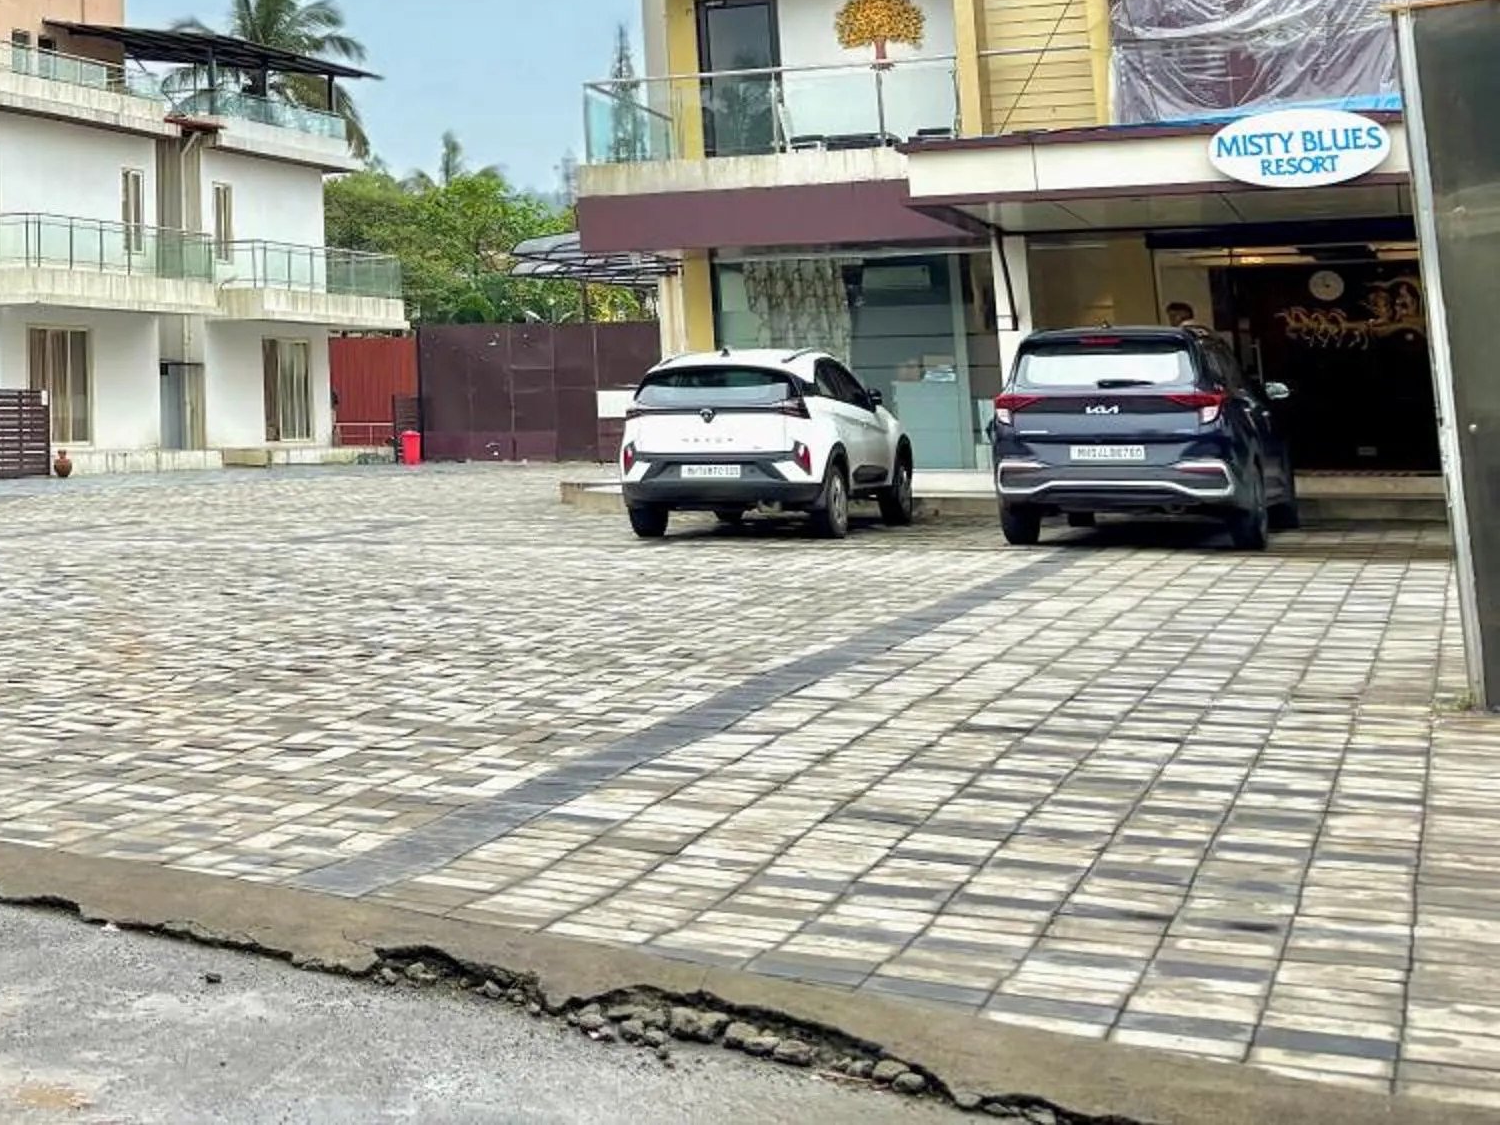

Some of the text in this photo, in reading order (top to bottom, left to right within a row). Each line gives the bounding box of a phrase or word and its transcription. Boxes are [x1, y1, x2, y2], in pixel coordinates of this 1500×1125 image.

[1216, 126, 1382, 158] MISTY BLUES
[1260, 155, 1339, 176] RESORT
